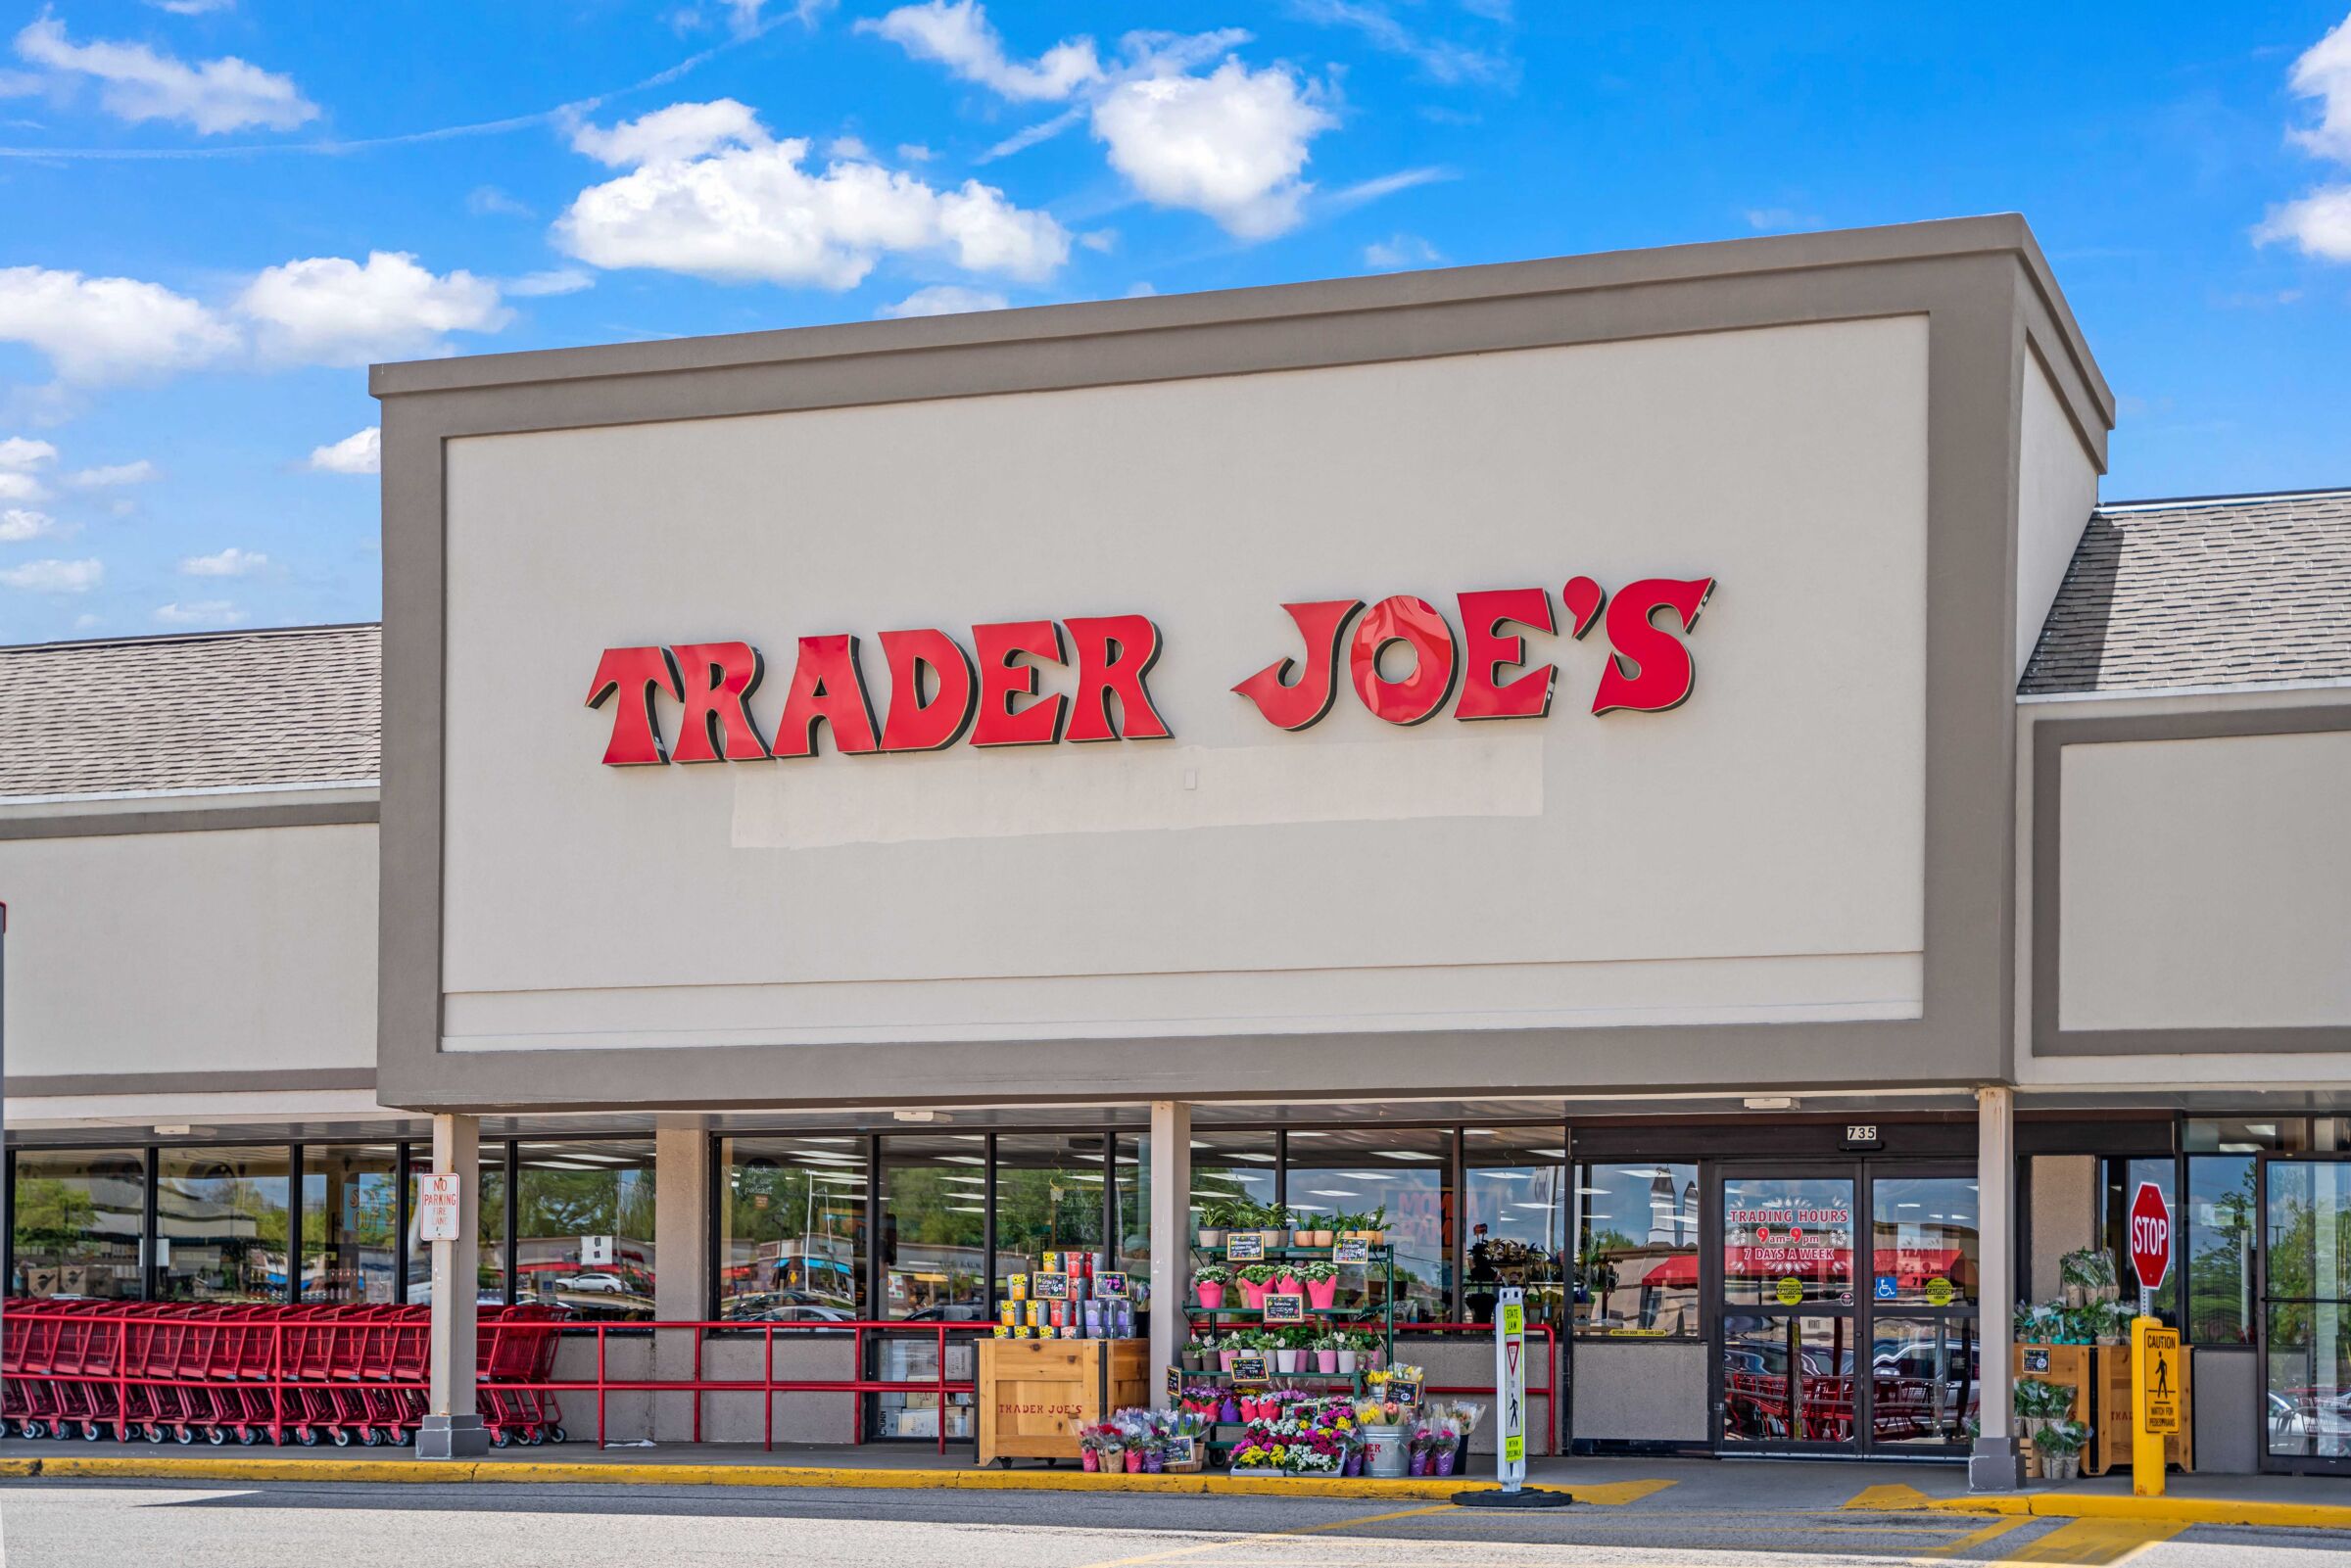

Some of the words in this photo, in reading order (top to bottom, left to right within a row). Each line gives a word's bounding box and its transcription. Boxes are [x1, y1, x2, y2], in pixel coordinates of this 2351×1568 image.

[584, 613, 1176, 767] TRADER
[1229, 575, 1717, 734] JOE'S
[1848, 1127, 1875, 1139] 735
[433, 1179, 447, 1191] NO
[424, 1194, 456, 1206] PARKING
[1729, 1210, 1793, 1223] TRADING
[1799, 1210, 1848, 1223] HOURS
[2134, 1215, 2168, 1256] STOP
[1744, 1249, 1751, 1260] 7
[1754, 1249, 1784, 1260] DAYS
[1788, 1249, 1798, 1260] A
[1799, 1249, 1835, 1260] WEEK
[1507, 1309, 1518, 1319] STATE
[2147, 1335, 2176, 1349] CAUTION
[999, 1403, 1044, 1414] TRADER
[1048, 1403, 1082, 1414] JOE'S
[2150, 1406, 2164, 1416] WATCH
